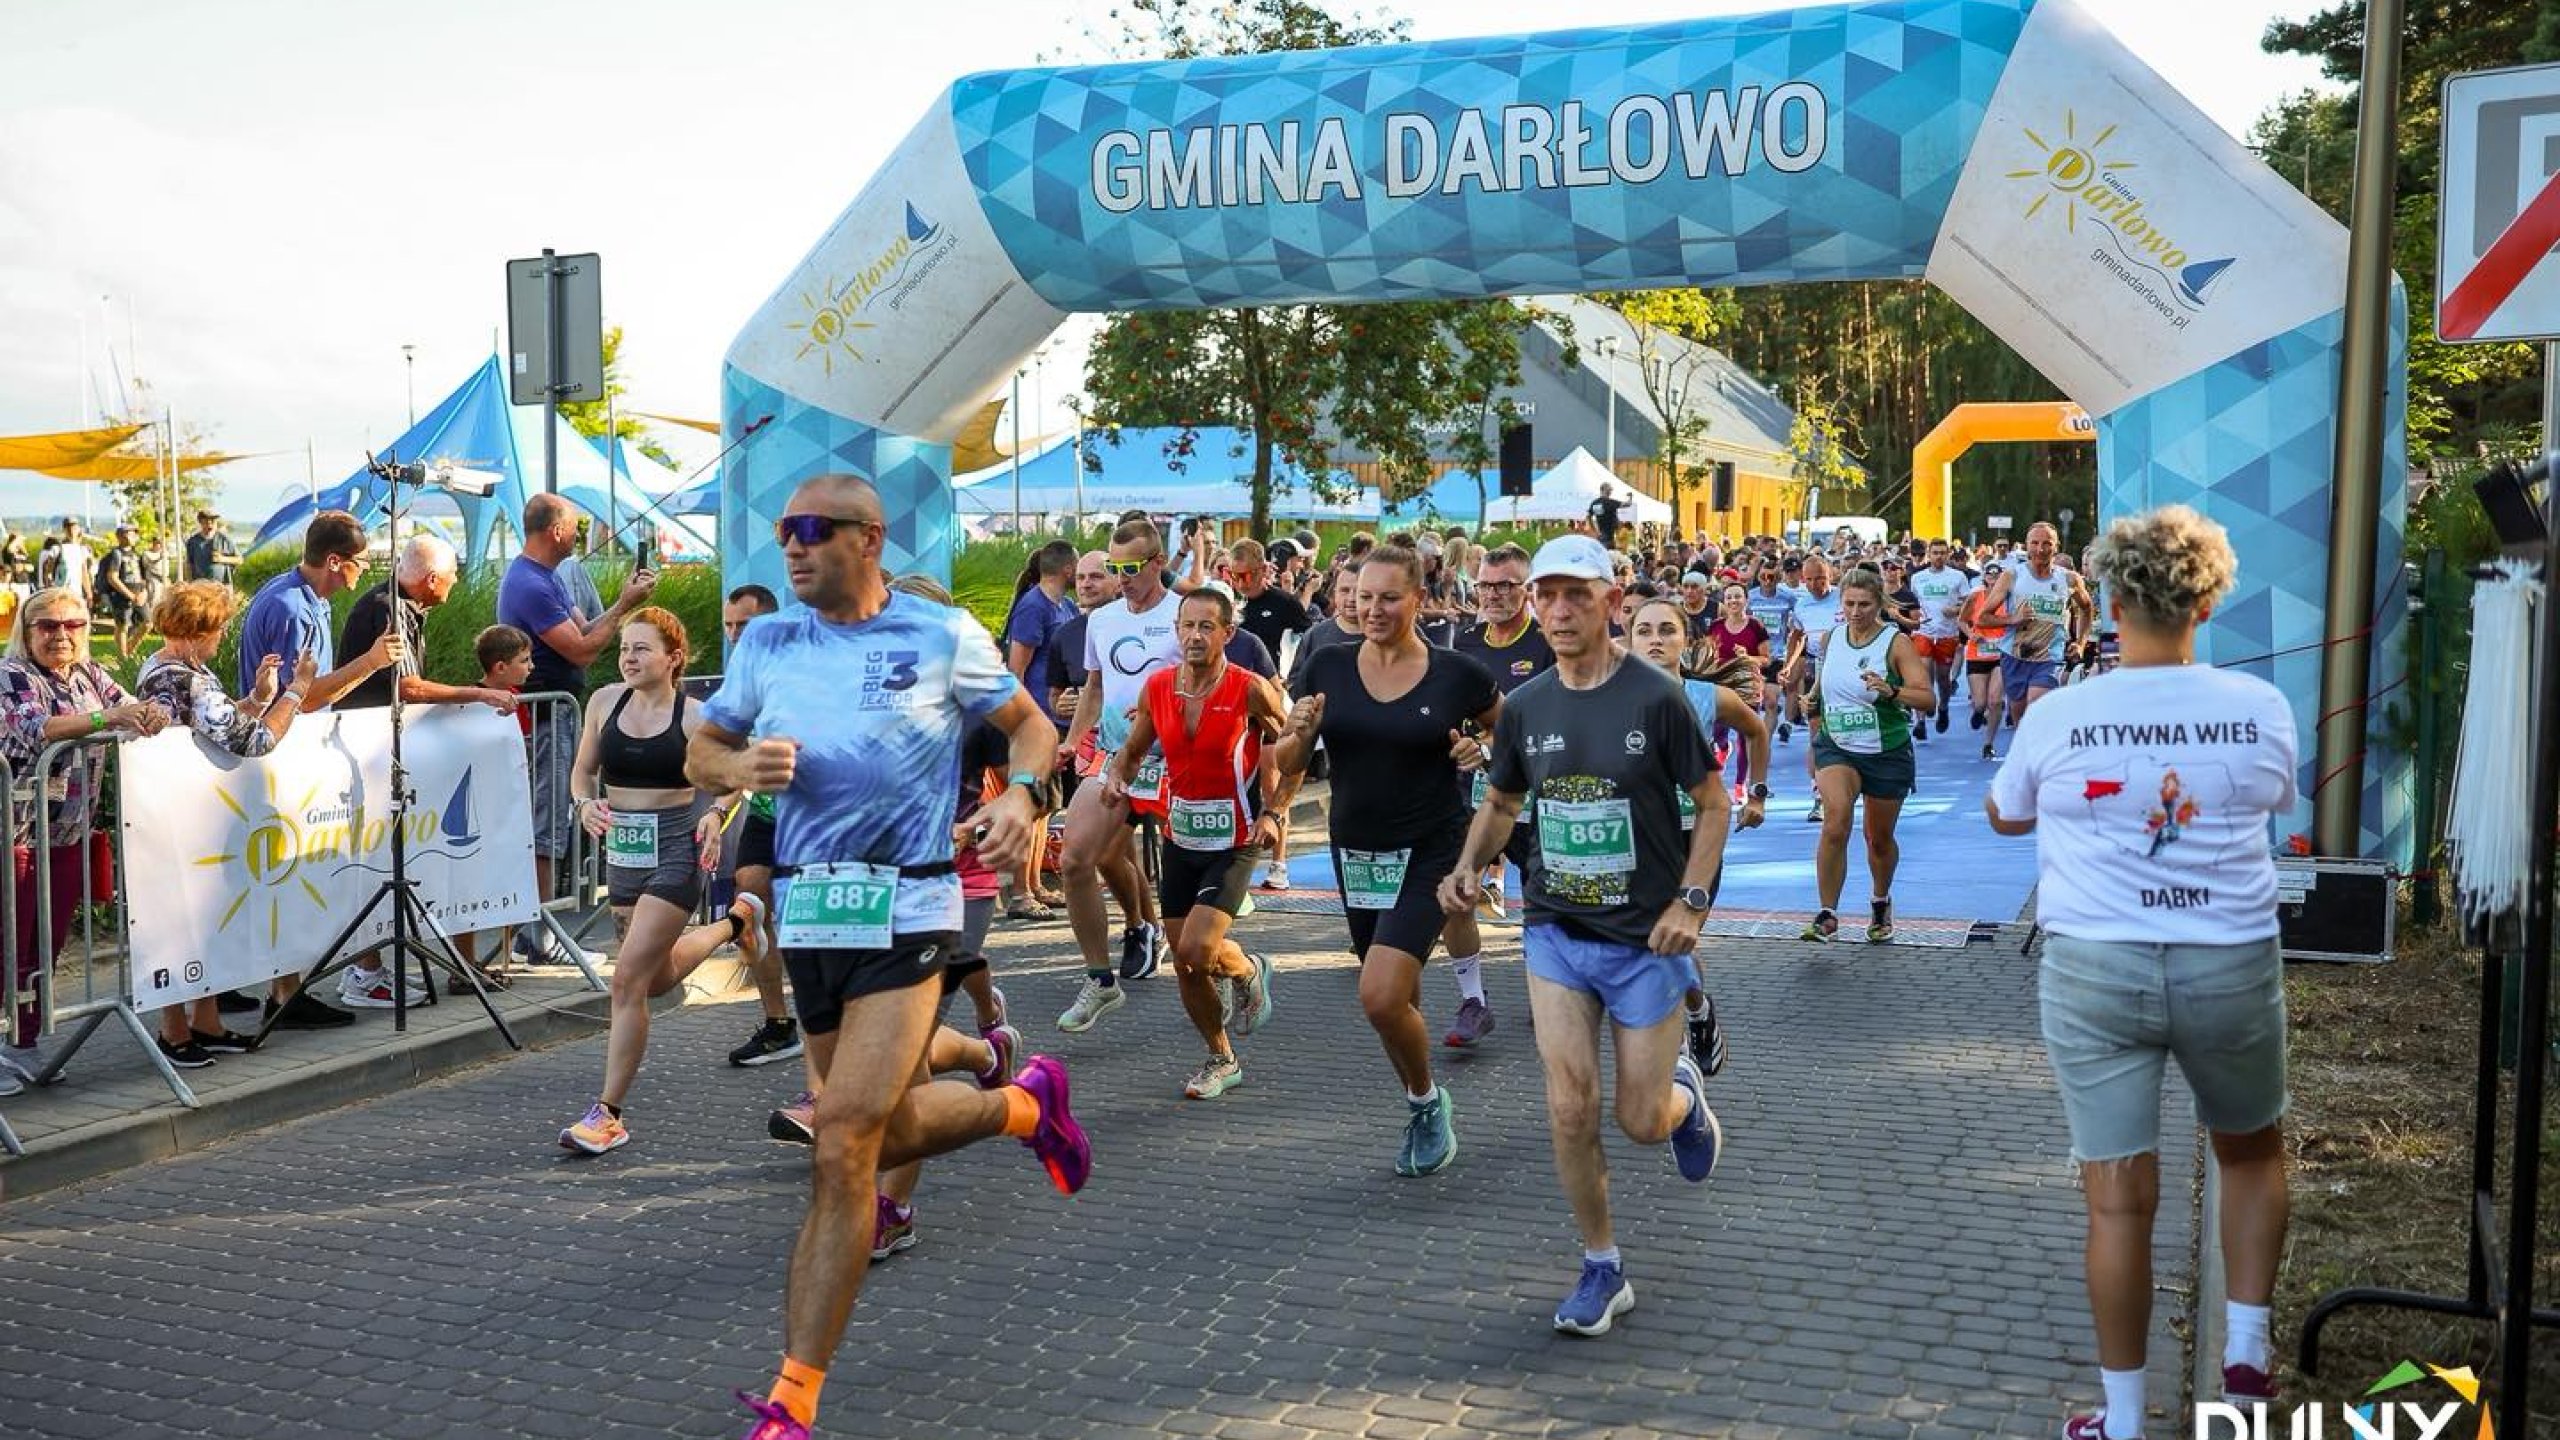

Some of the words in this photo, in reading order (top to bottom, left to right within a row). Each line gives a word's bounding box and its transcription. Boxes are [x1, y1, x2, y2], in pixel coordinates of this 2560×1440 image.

[1092, 118, 1361, 213] GMINA
[1385, 81, 1827, 198] DARŁOWO
[2090, 248, 2191, 333] gminadarlowo.pl
[863, 651, 883, 692] BIEG
[882, 651, 919, 690] 3
[1844, 712, 1874, 726] 803
[2070, 724, 2189, 749] AKTYWNA
[2195, 717, 2259, 744] WIEŚ
[1192, 813, 1230, 829] 890
[1570, 820, 1624, 844] 867
[618, 827, 653, 845] 884
[825, 884, 887, 911] 887
[2141, 887, 2210, 910] DĄBKI
